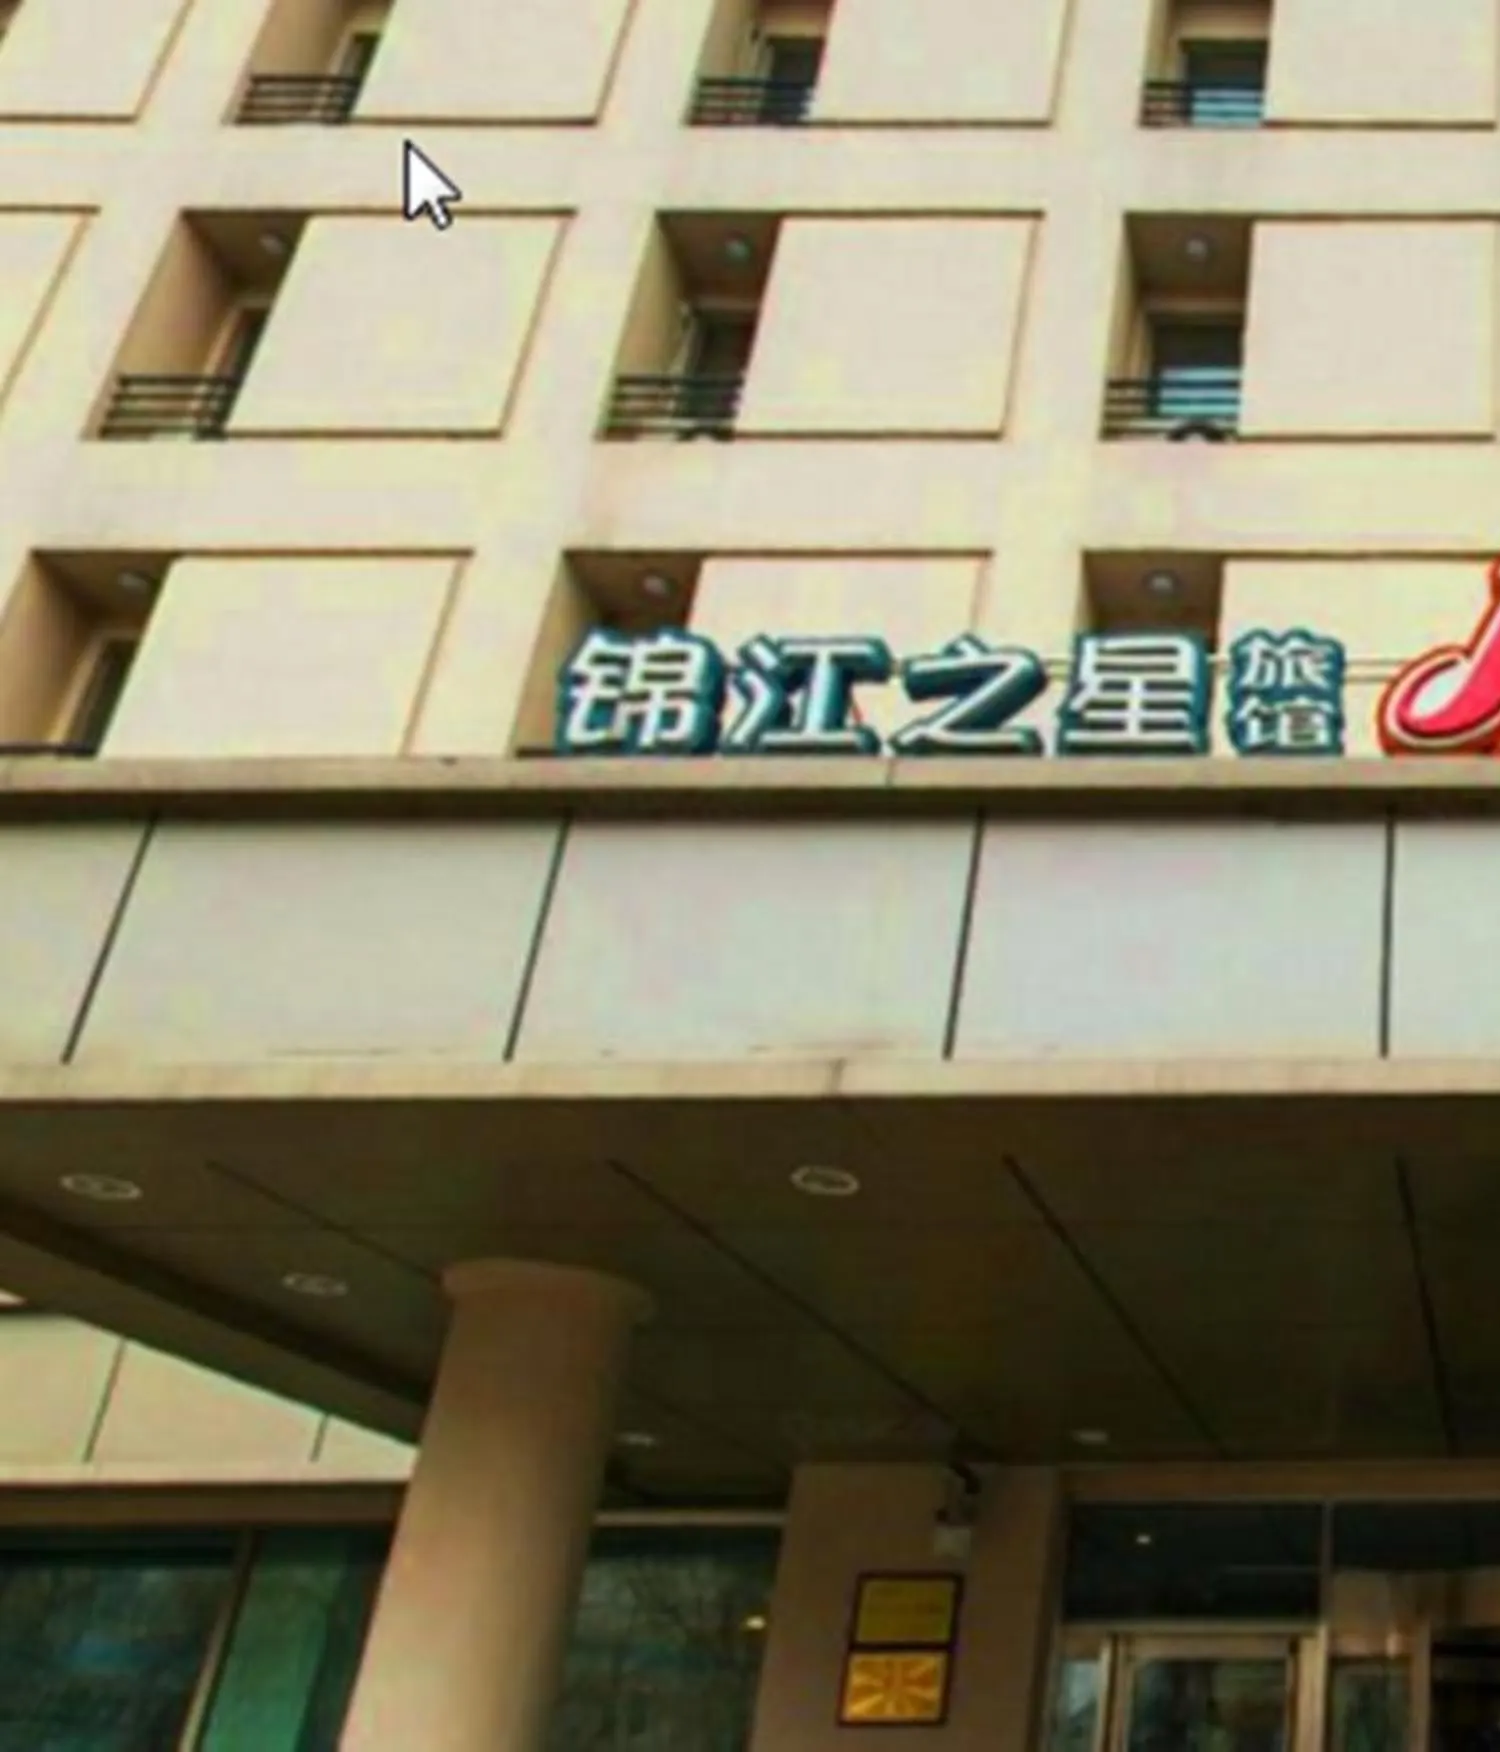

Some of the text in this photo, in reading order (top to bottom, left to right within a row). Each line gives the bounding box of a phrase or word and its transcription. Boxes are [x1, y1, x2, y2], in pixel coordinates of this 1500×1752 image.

[560, 632, 1200, 753] 锦江之星
[1233, 631, 1342, 753] 旅馆
